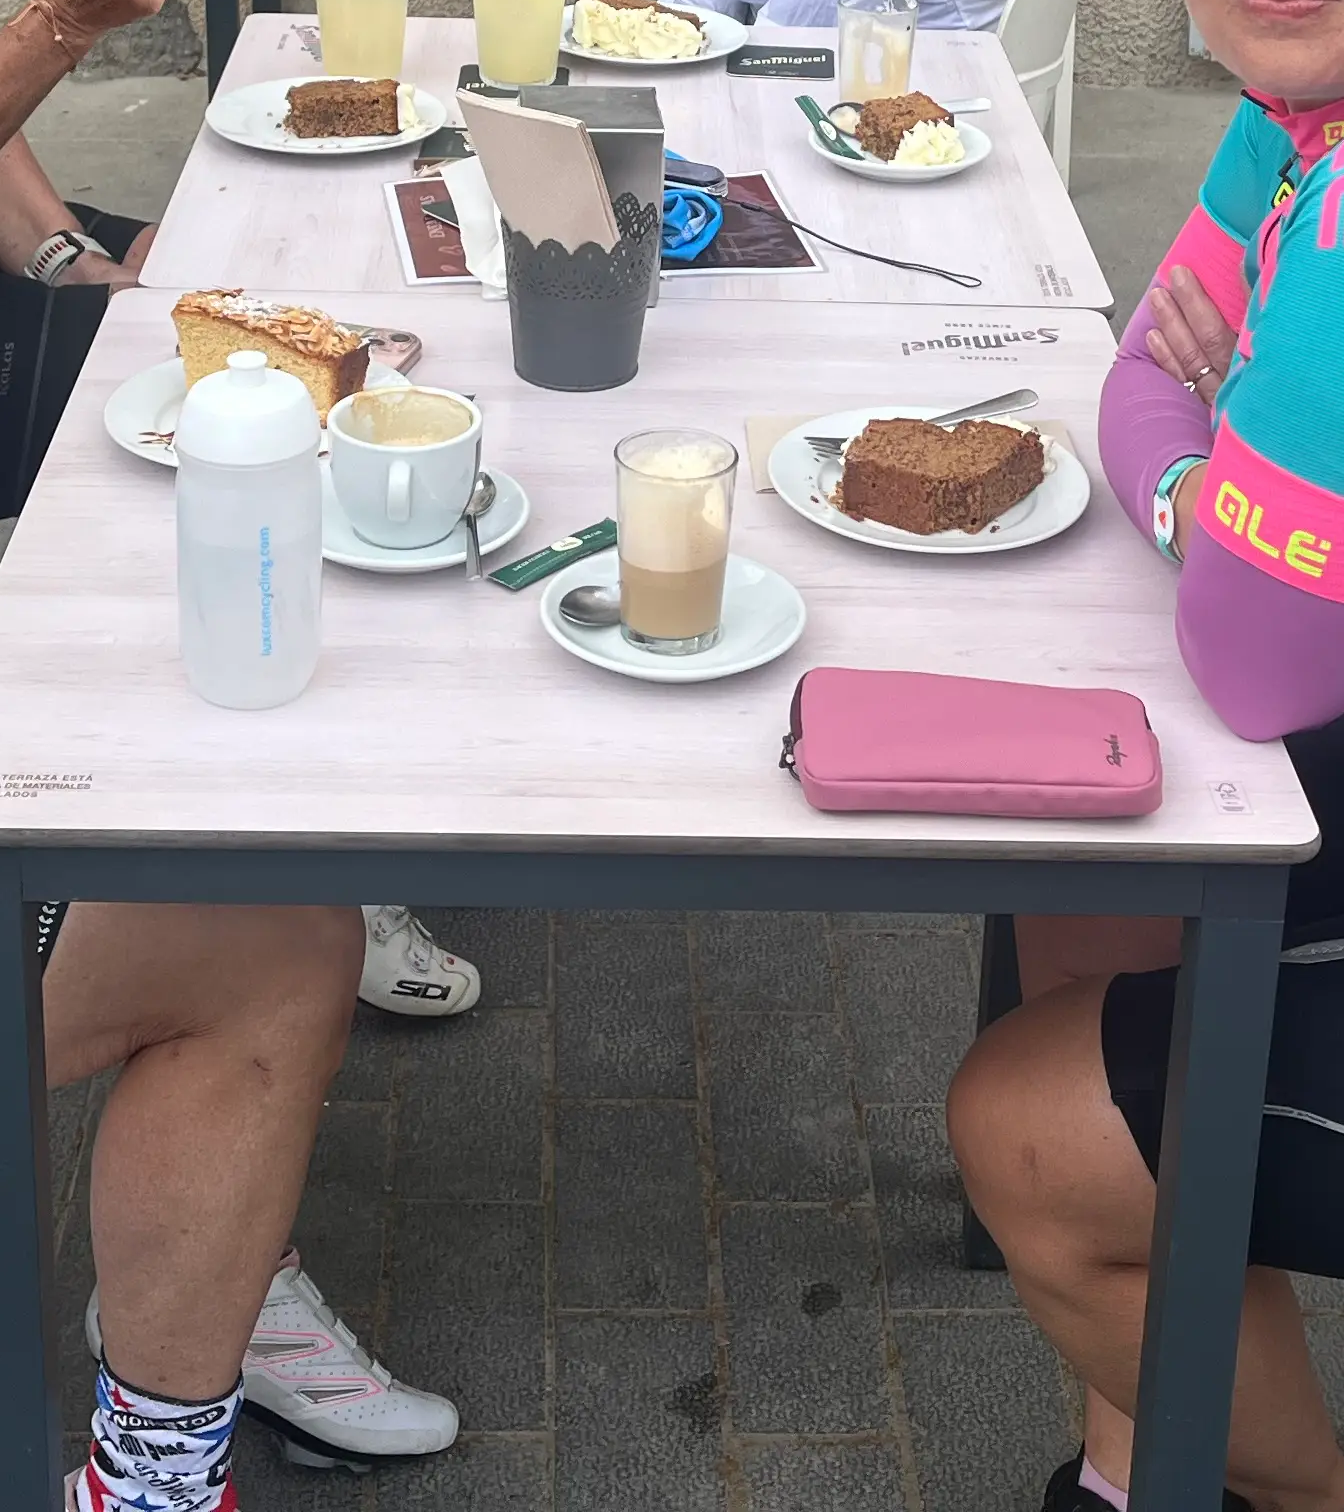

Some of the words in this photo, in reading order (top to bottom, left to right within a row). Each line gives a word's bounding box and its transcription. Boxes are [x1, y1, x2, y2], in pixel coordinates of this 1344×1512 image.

[901, 327, 1061, 356] SanMiguel
[1, 773, 58, 781] TERRAZA
[22, 782, 92, 790] MATERIALES
